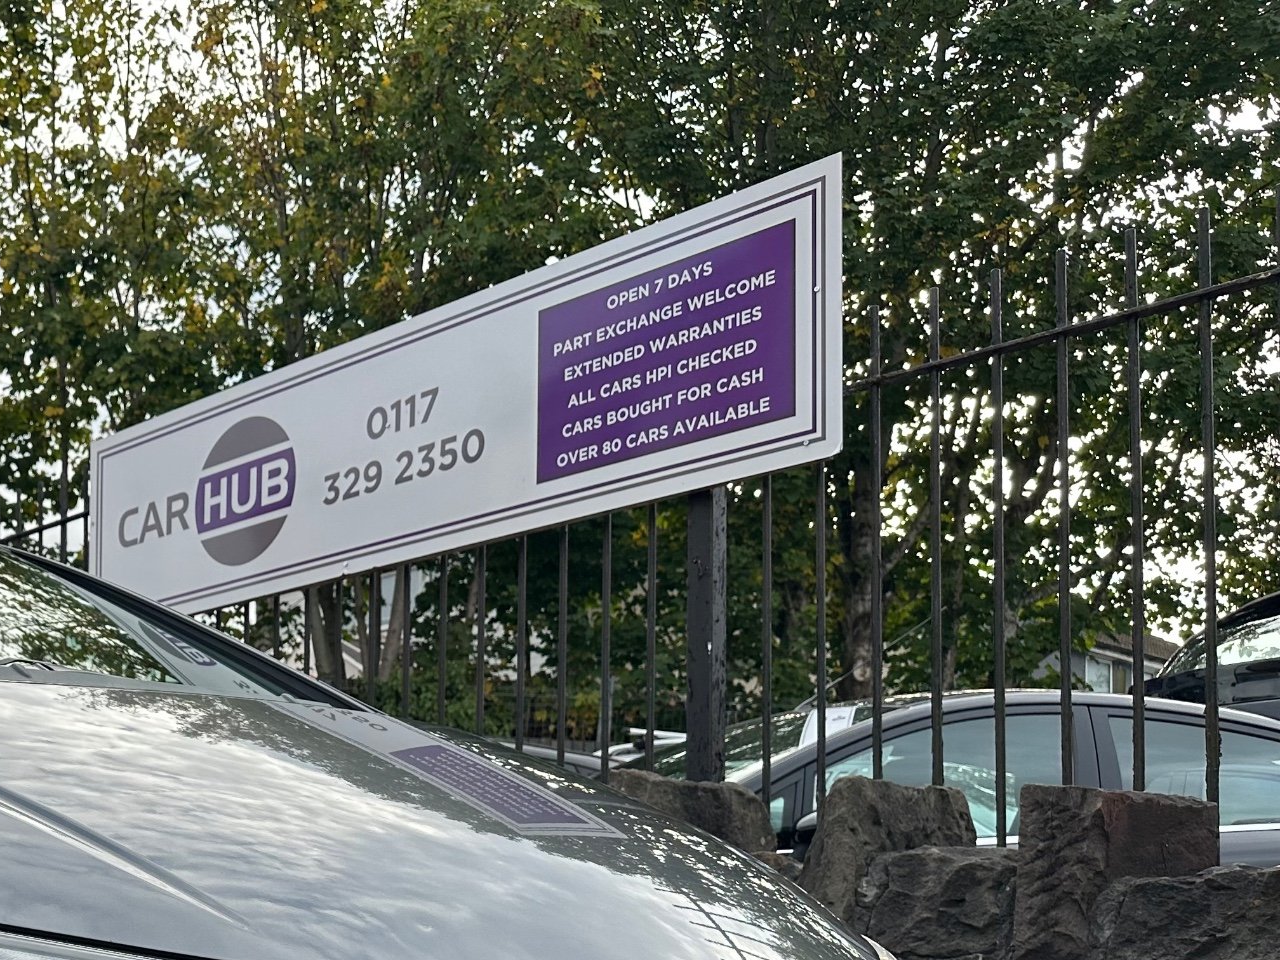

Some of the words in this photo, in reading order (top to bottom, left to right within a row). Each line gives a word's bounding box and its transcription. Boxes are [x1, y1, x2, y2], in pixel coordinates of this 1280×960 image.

[553, 332, 592, 357] PART
[596, 301, 683, 343] EXCHANGE
[687, 269, 776, 312] WELCOME
[606, 283, 650, 310] OPEN
[654, 277, 664, 294] 7
[668, 261, 713, 290] DAYS
[564, 344, 645, 382] EXTENDED
[649, 306, 762, 354] WARRANTIES
[567, 388, 596, 409] ALL
[600, 374, 642, 399] CARS
[645, 364, 672, 386] HPI
[677, 338, 758, 375] CHECKED
[366, 386, 440, 440] 0117
[556, 444, 598, 468] OVER
[602, 437, 622, 454] 80
[625, 425, 669, 449] CARS
[672, 396, 771, 437] AVAILABLE
[562, 414, 603, 438] CARS
[606, 394, 673, 426] BOUGHT
[677, 382, 712, 405] FOR
[716, 367, 765, 394] CASH
[118, 491, 190, 548] CAR
[203, 458, 290, 524] HUB
[323, 460, 382, 506] 329
[394, 428, 486, 486] 2350
